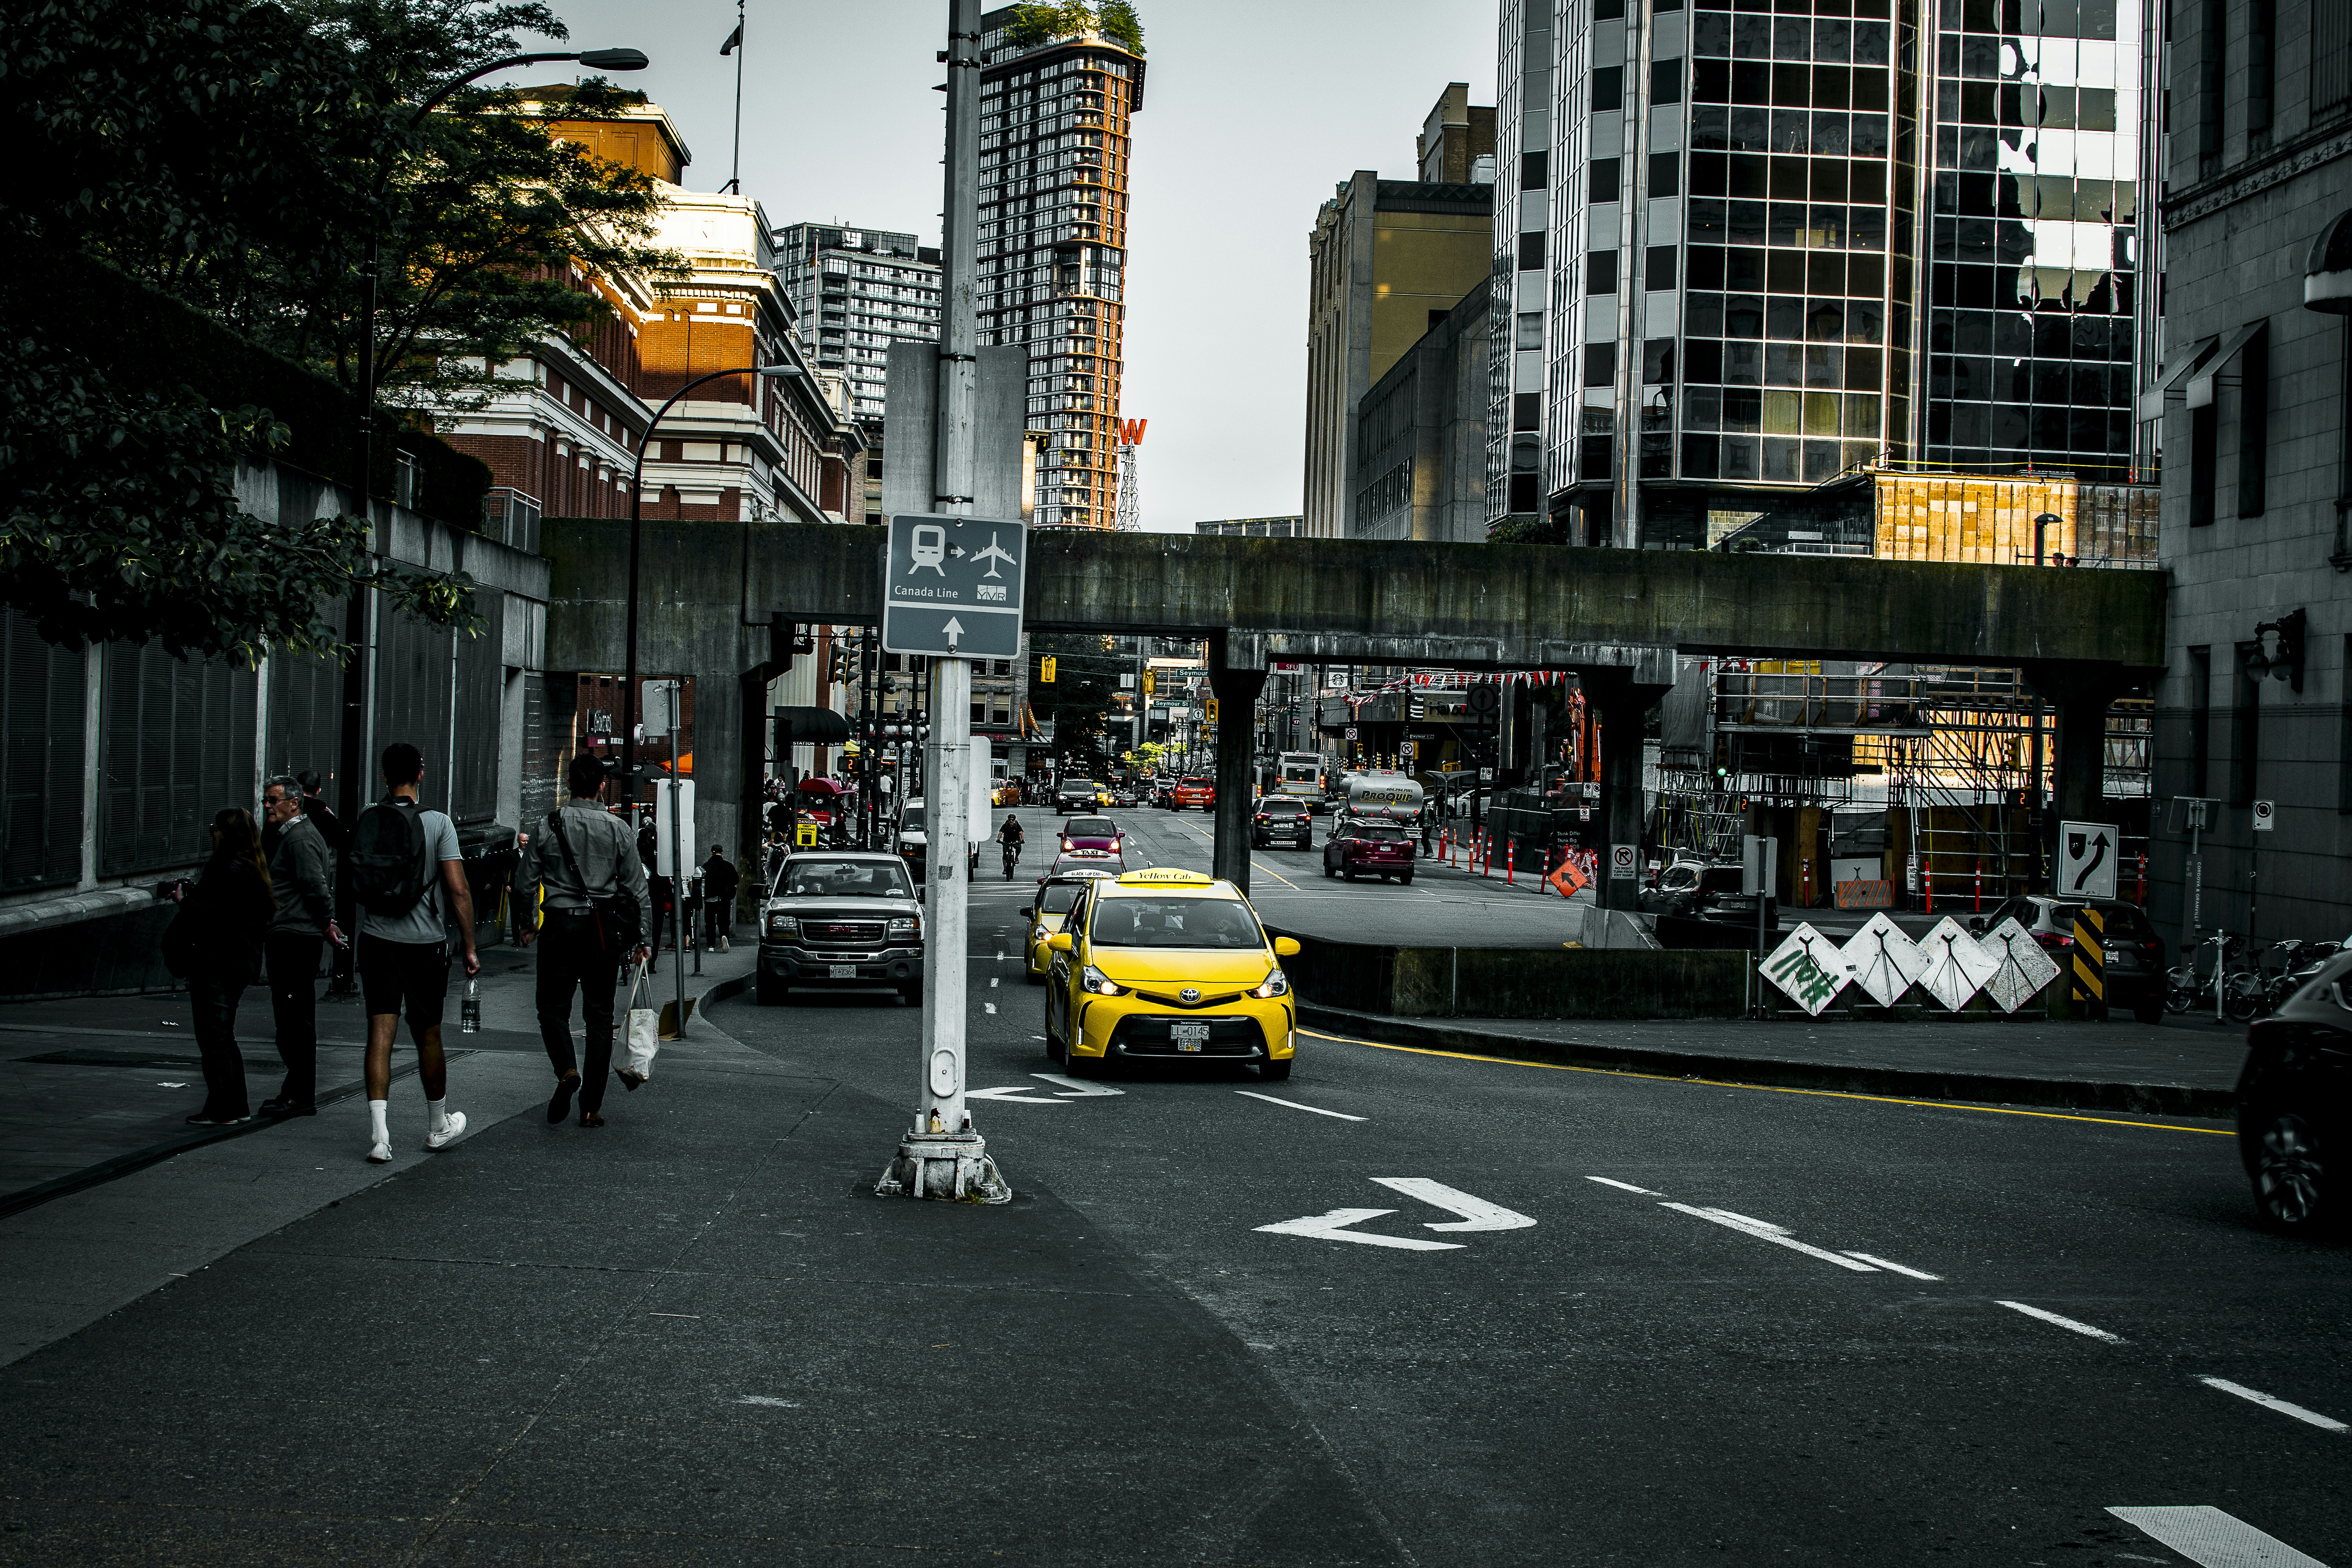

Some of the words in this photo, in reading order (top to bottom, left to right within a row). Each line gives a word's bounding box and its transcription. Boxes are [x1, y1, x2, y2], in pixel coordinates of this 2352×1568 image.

[1119, 419, 1147, 445] W
[895, 585, 933, 597] Canada
[937, 588, 958, 599] Line
[977, 591, 1006, 601] YVR
[1027, 708, 1040, 732] STEAMWORKS
[848, 759, 853, 769] 2
[2020, 793, 2025, 804] 2
[1742, 799, 1747, 810] 2
[1172, 1026, 1182, 1036] LL
[1187, 1026, 1208, 1036] 0145
